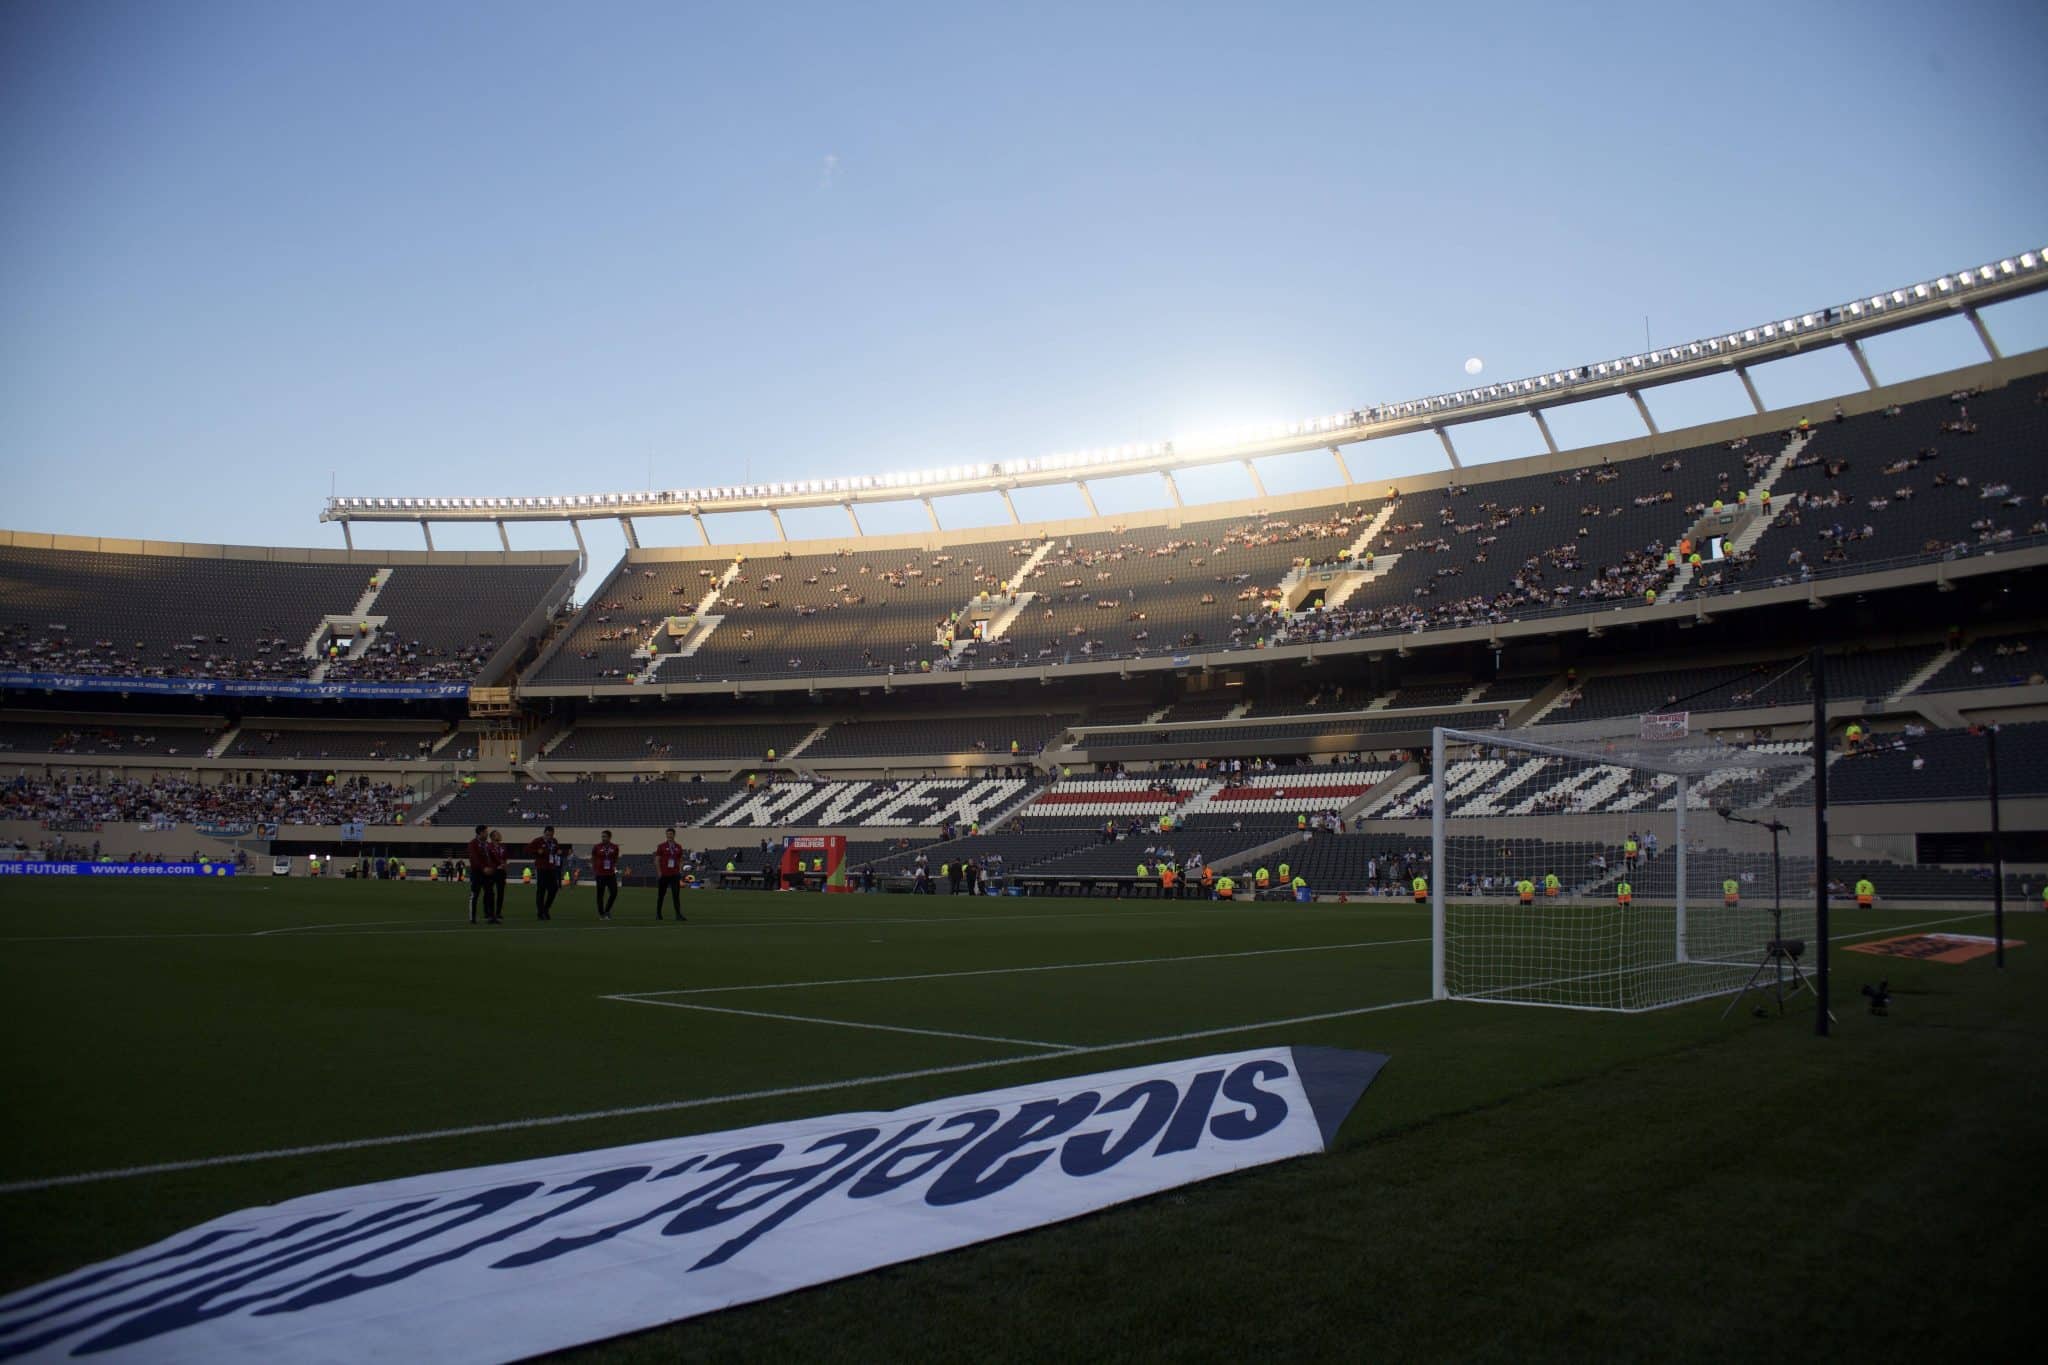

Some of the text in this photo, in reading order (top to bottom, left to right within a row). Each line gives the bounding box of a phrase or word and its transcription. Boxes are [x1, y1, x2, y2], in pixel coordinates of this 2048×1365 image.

[53, 678, 84, 687] YPF
[187, 682, 217, 690] YPF
[319, 686, 347, 694] YPF
[438, 686, 465, 694] YPF
[715, 779, 1027, 827] RIVER
[0, 863, 195, 874] THE FUTURE www.eeee.com
